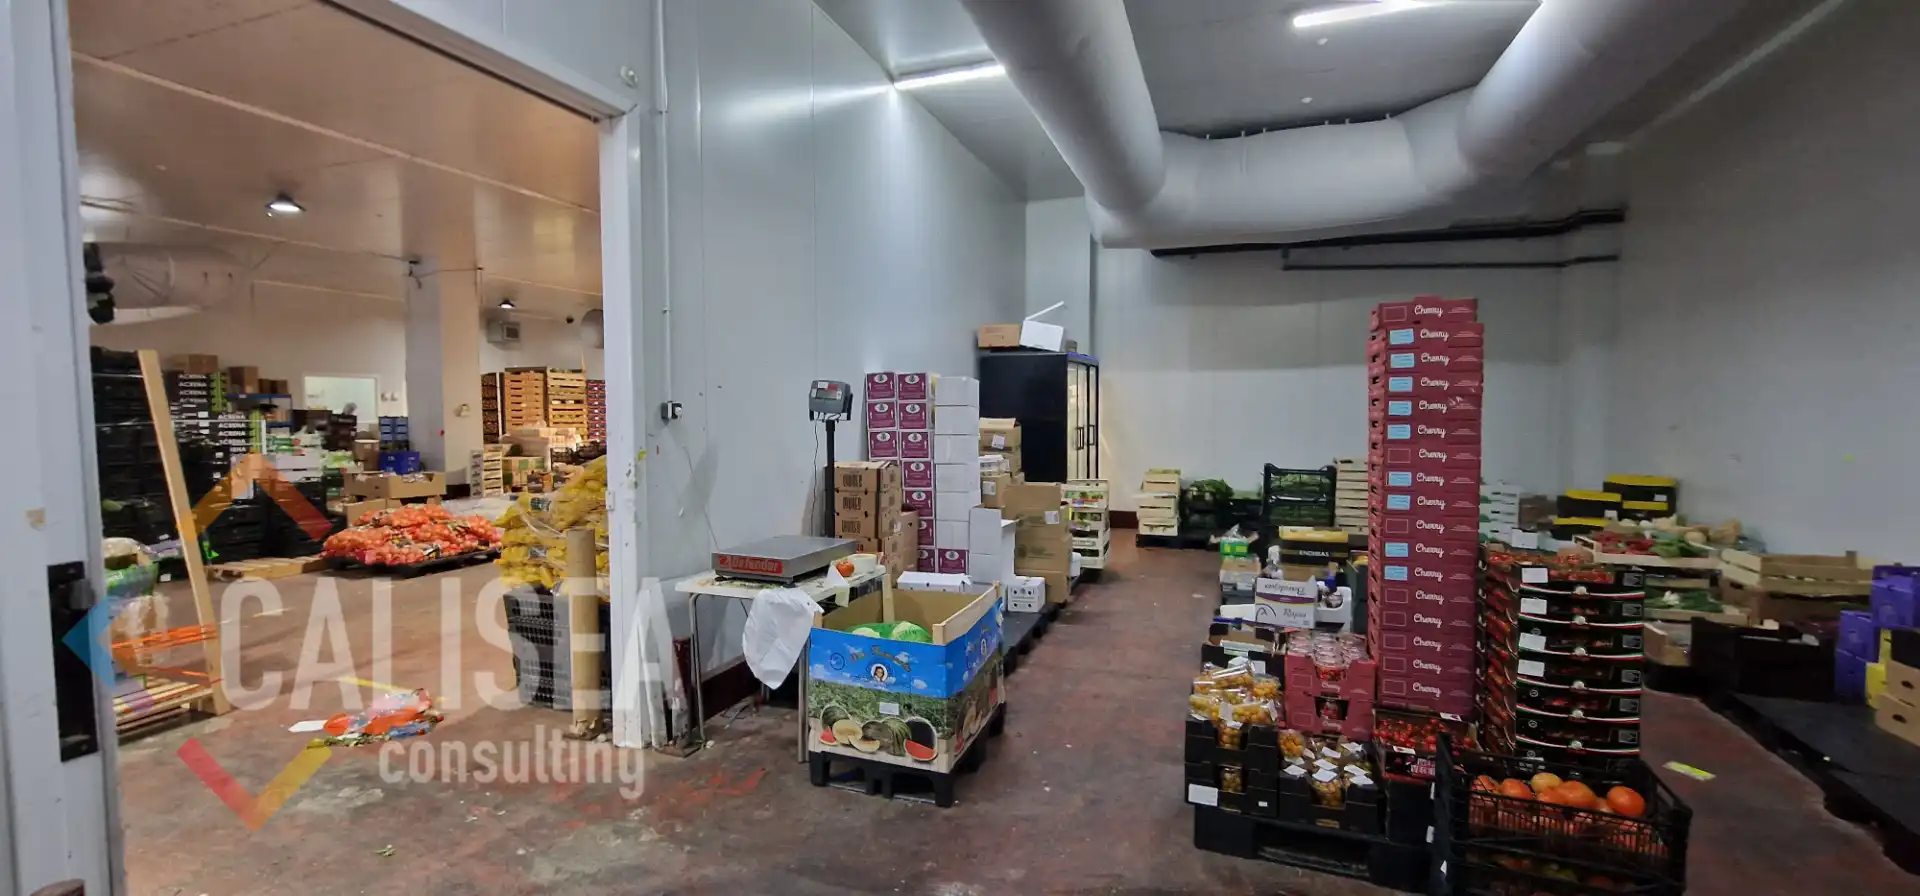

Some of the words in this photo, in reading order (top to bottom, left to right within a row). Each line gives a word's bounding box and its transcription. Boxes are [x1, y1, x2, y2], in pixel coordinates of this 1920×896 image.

[1415, 305, 1443, 317] Cherry
[1420, 328, 1449, 341] Cherry
[1421, 352, 1450, 366] Cherry
[1421, 376, 1449, 390] Cherry
[1419, 400, 1447, 413] Cherry
[1418, 424, 1446, 438] Cherry
[1419, 448, 1447, 462] Cherry
[1417, 472, 1445, 486] Cherry
[1417, 496, 1446, 510] Cherry
[1416, 520, 1445, 534] Cherry
[1415, 543, 1444, 557] Cherry
[732, 555, 777, 572] Defender
[1415, 566, 1443, 581] Cherry
[1415, 590, 1444, 604] Cherry
[1413, 613, 1442, 628] Cherry
[1413, 636, 1442, 651] Cherry
[1413, 659, 1442, 674] Cherry
[1413, 682, 1442, 697] Cherry
